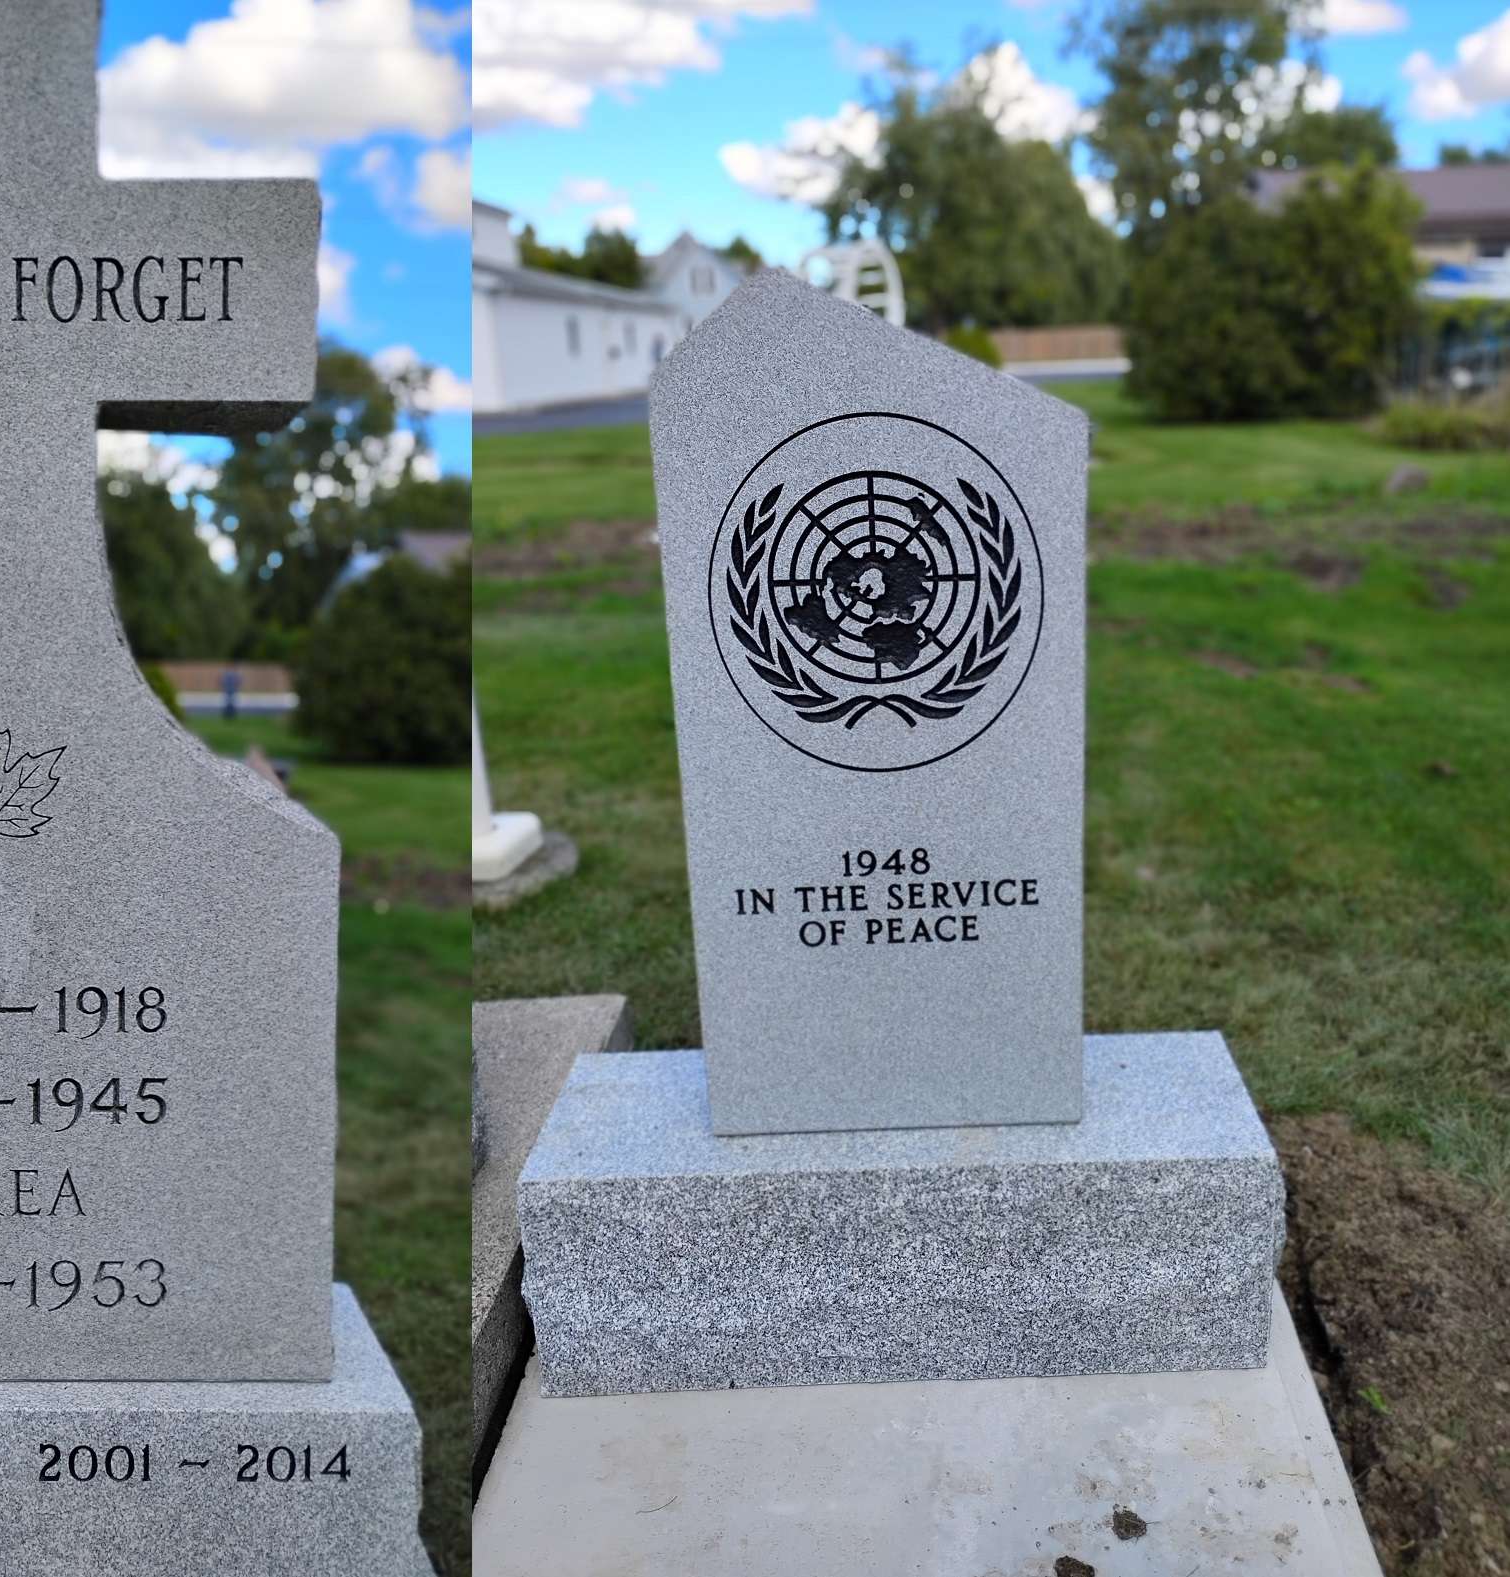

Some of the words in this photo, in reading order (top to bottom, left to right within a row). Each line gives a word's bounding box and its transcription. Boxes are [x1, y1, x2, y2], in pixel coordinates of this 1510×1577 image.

[11, 254, 244, 323] FORGET
[841, 847, 931, 877] 1948
[735, 889, 775, 914] IN
[794, 884, 868, 912] THE
[887, 879, 1039, 910] SERVICE
[799, 920, 846, 947] OF
[865, 915, 979, 944] PEACE
[54, 986, 167, 1039] 1918
[38, 1443, 152, 1482] 2001
[236, 1443, 352, 1482] 2014
